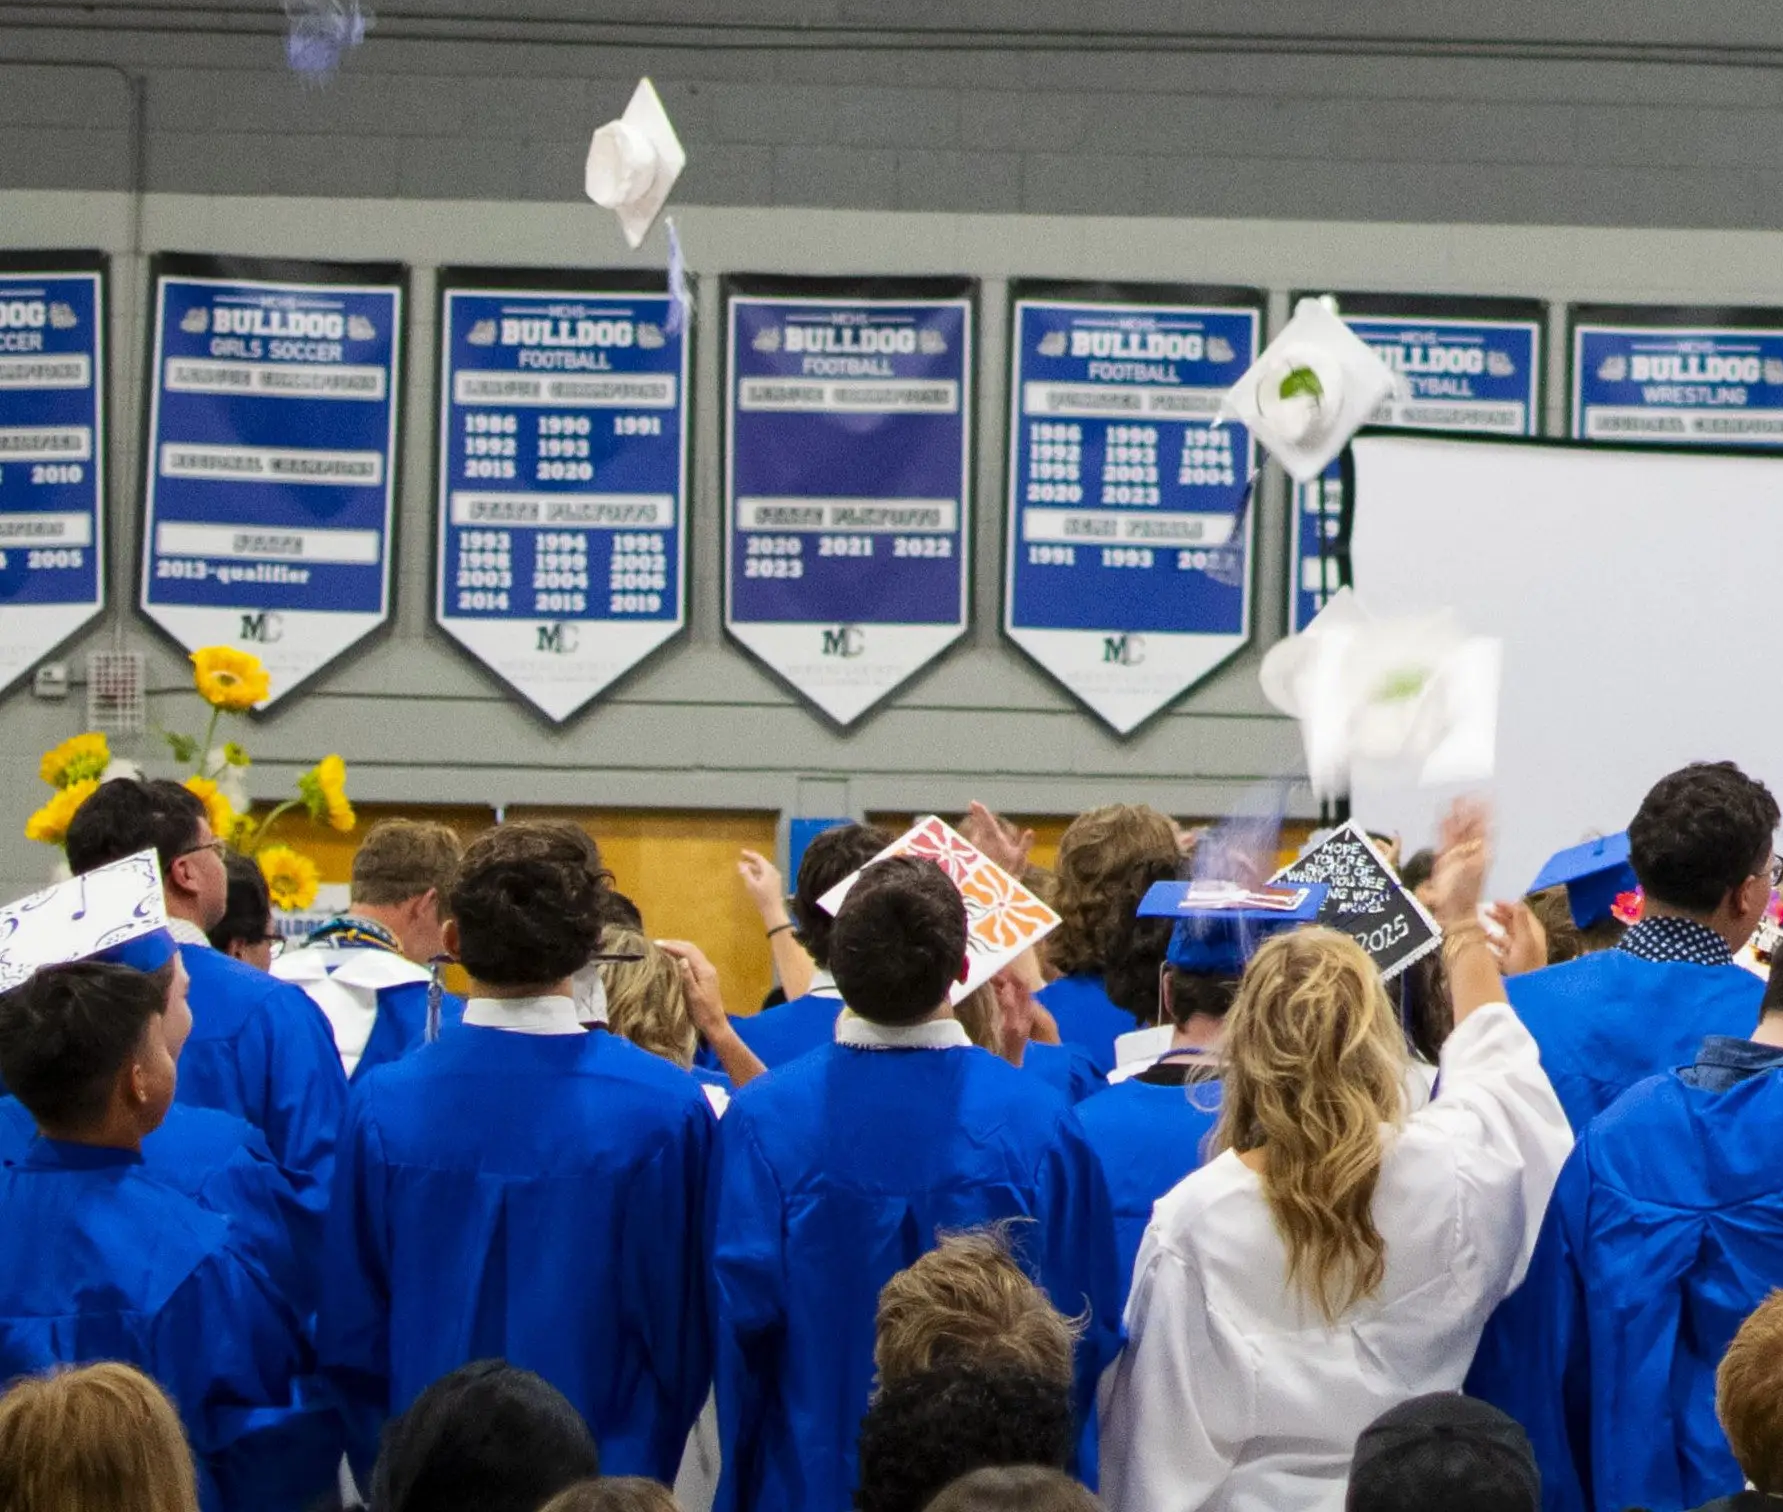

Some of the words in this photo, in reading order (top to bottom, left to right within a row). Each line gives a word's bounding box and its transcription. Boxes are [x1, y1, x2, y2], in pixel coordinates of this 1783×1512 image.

[213, 308, 344, 339] BULLDOG
[501, 318, 633, 348] BULLDOG
[210, 338, 263, 358] GIRLS
[269, 342, 343, 361] SOCCER
[784, 326, 917, 355] BULLDOG
[1071, 331, 1203, 361] BULLDOG
[518, 349, 612, 370] FOOTBALL
[803, 356, 894, 376] FOOTBALL
[1373, 345, 1482, 374] ULLDOG
[1631, 355, 1761, 383] BULLDOG
[1088, 362, 1182, 383] FOOTBALL
[1641, 386, 1747, 406] WRESTLING
[538, 415, 591, 435] 1990
[614, 416, 661, 436] 1991
[465, 437, 517, 457] 1992
[537, 438, 589, 458] 1993
[1185, 428, 1231, 447] 1991
[31, 464, 83, 484] 2010
[464, 459, 516, 479] 2015
[536, 461, 594, 481] 2020
[1027, 482, 1083, 502] 2020
[746, 536, 802, 556] 2020
[818, 536, 873, 556] 2021
[893, 537, 951, 557] 2022
[1028, 545, 1075, 565] 1991
[1102, 548, 1154, 568] 1993
[155, 559, 311, 585] 2013-qualifier
[745, 557, 803, 578] 2023
[458, 590, 509, 610] 2014
[1322, 842, 1361, 855] HOPE
[1286, 870, 1323, 883] WHAT
[1330, 876, 1355, 887] YOU
[1358, 876, 1386, 890] SEE
[1305, 863, 1350, 877] PROUD
[1354, 864, 1376, 876] OF
[1356, 913, 1409, 952] 2025
